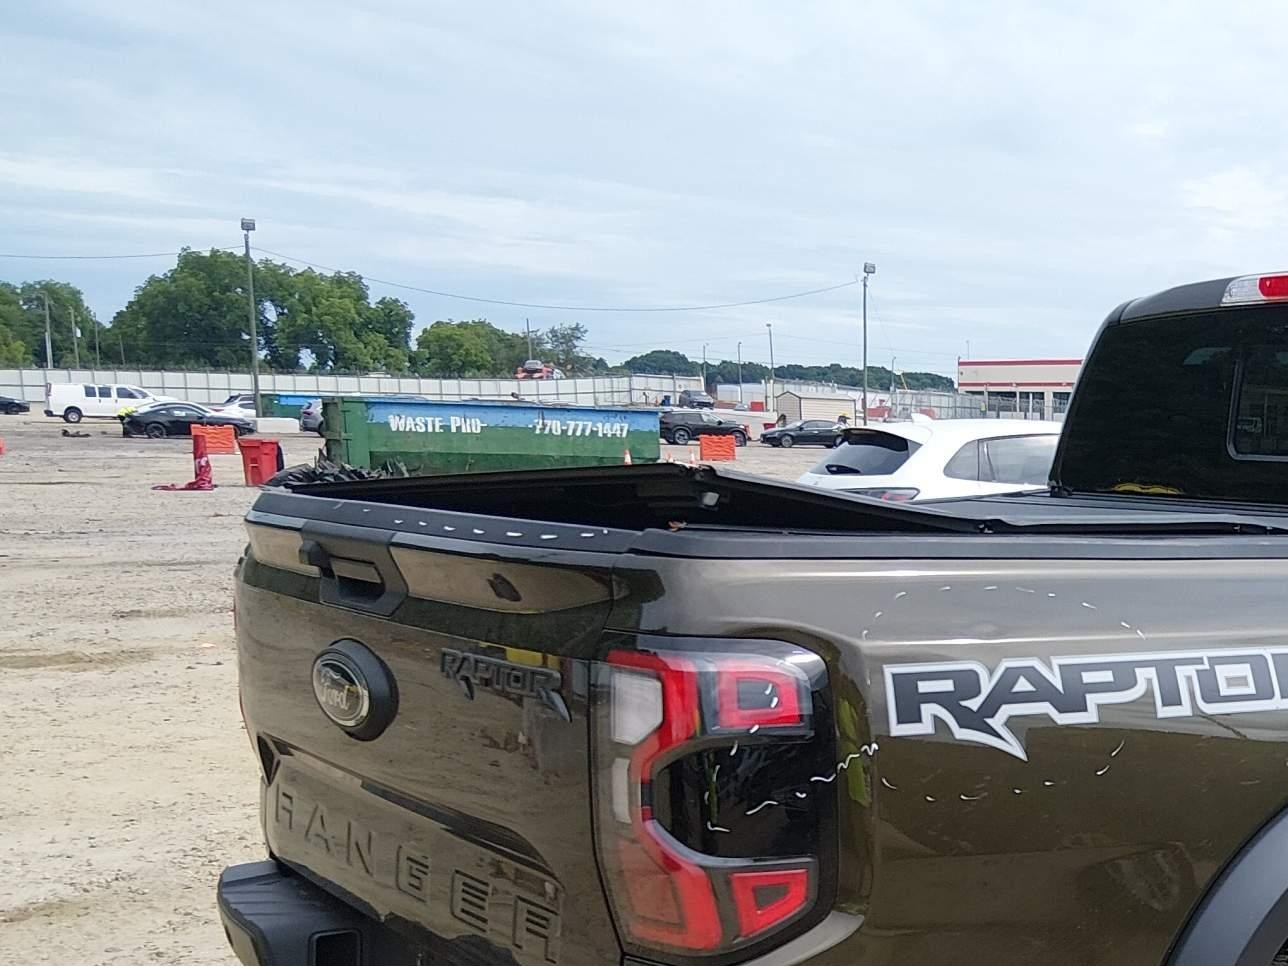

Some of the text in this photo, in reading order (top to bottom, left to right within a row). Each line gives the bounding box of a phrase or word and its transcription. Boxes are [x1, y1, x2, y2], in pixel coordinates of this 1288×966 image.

[388, 414, 444, 432] WASTE
[320, 667, 351, 711] Ford
[440, 648, 572, 723] RAPTOR
[276, 783, 562, 964] RANGER
